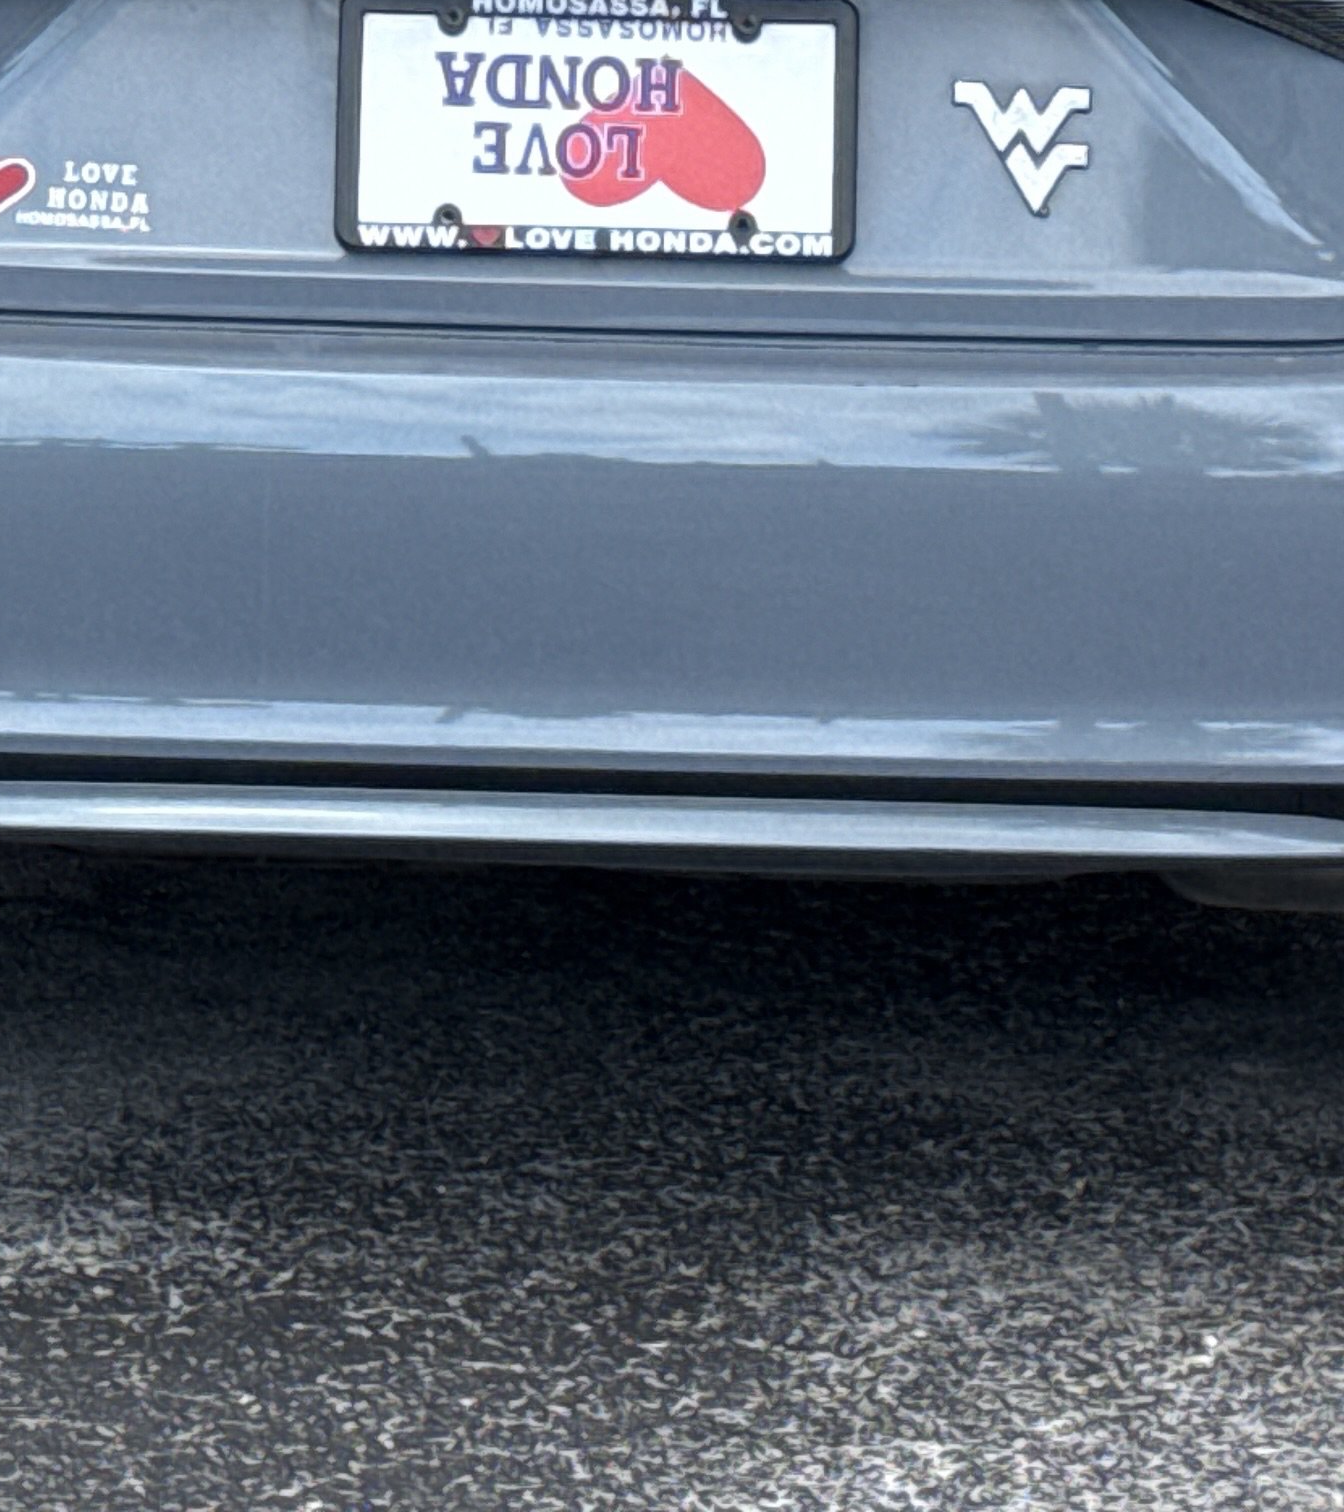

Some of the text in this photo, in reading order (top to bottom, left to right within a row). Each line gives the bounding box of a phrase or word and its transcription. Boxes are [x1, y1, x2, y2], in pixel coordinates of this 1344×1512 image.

[435, 51, 683, 112] HONDA
[472, 121, 644, 179] LOVE
[64, 161, 138, 186] LOVE
[47, 187, 149, 214] HONDA
[358, 224, 833, 256] WWW. LOVE HONDA.COM
